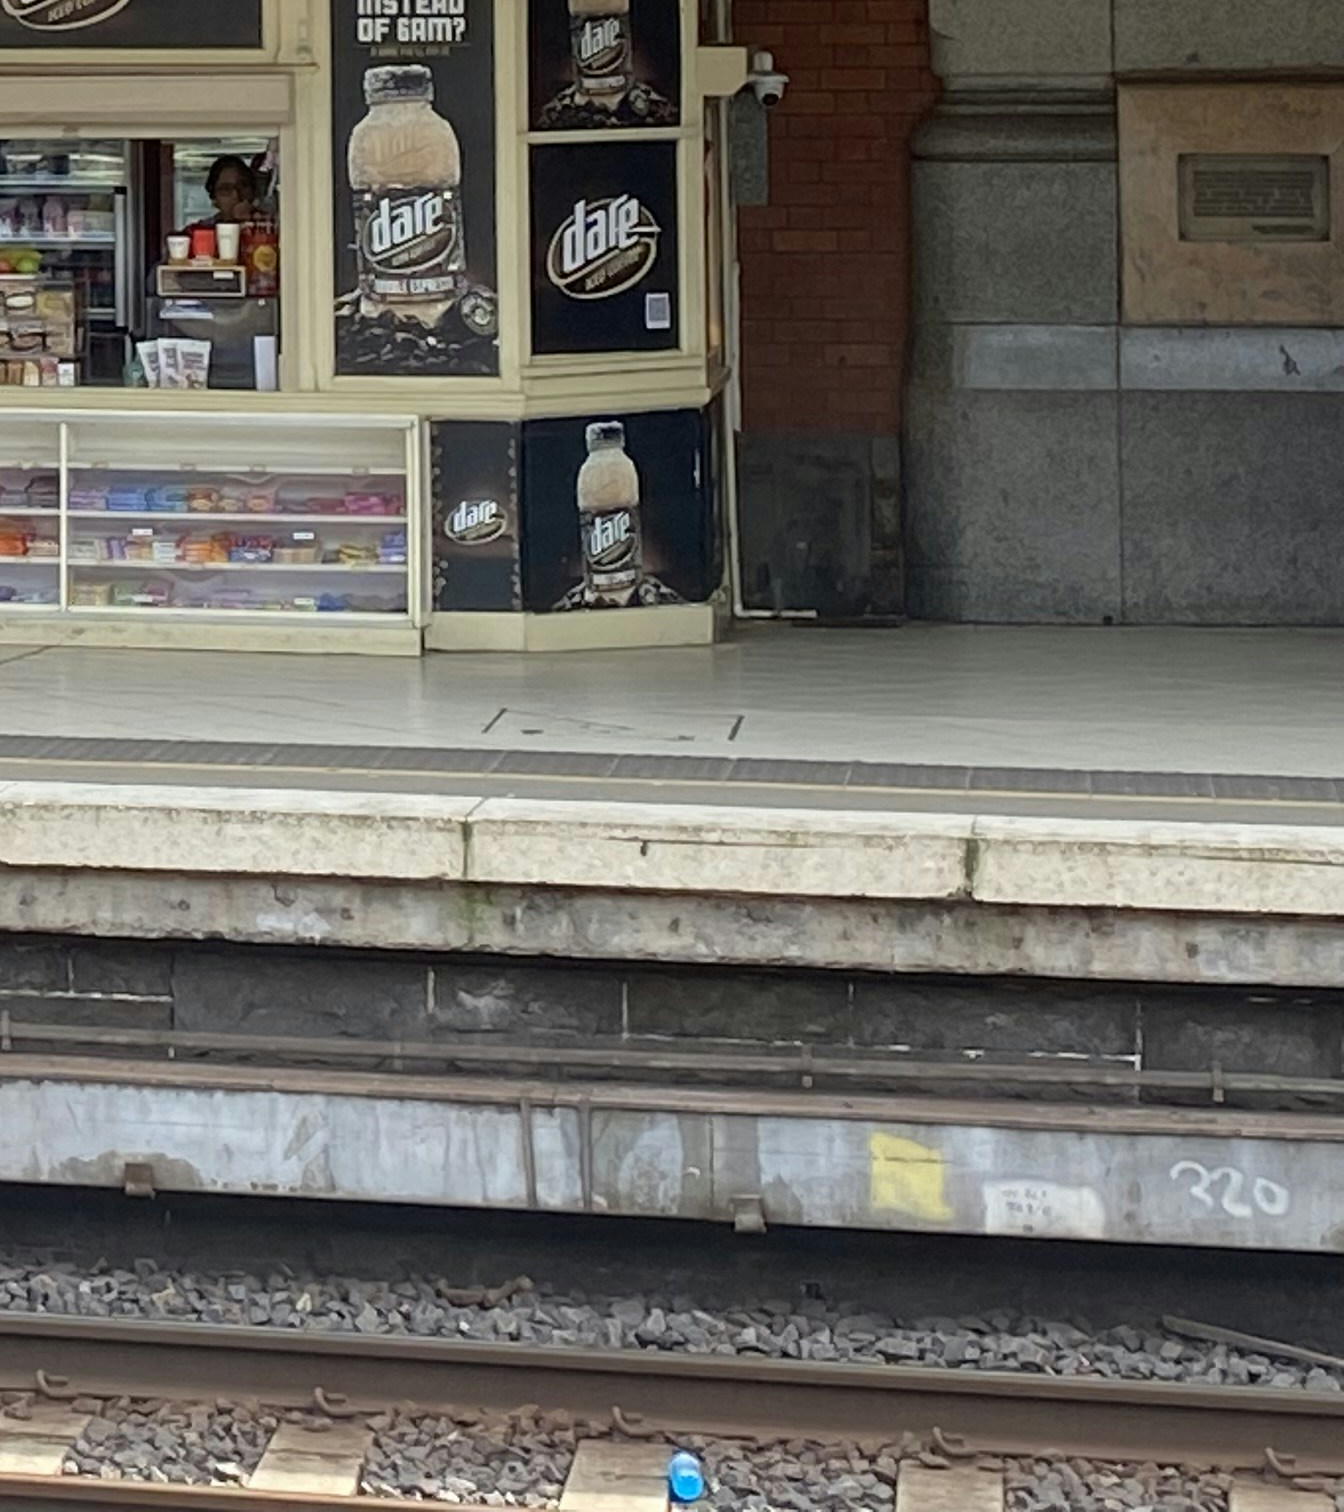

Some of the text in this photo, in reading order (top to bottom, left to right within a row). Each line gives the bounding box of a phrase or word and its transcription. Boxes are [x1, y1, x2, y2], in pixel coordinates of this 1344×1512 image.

[357, 17, 466, 43] OF 6AM?
[581, 18, 620, 59] dare
[371, 192, 445, 253] dare
[563, 194, 640, 273] dare
[453, 500, 498, 532] dare
[590, 512, 631, 555] dare
